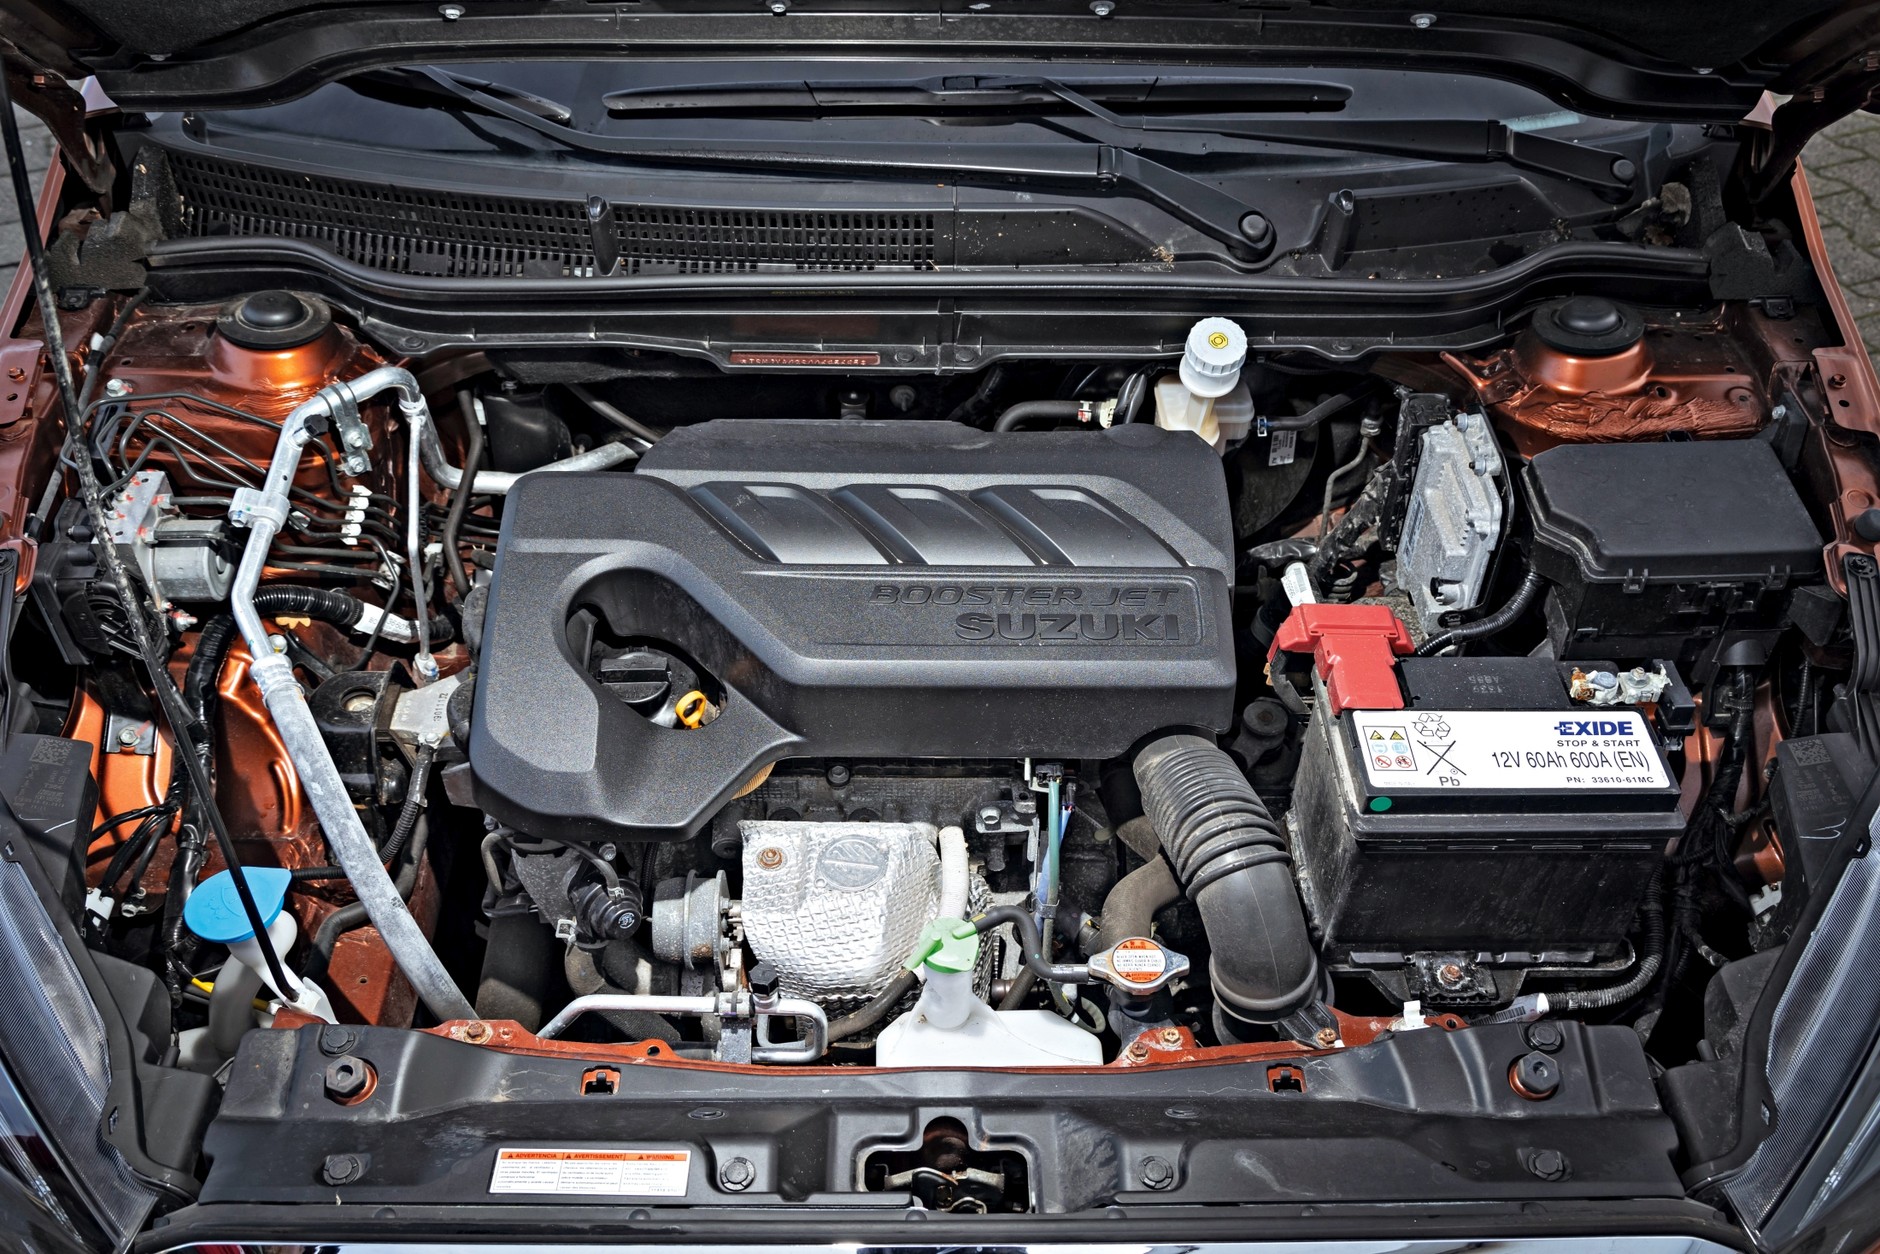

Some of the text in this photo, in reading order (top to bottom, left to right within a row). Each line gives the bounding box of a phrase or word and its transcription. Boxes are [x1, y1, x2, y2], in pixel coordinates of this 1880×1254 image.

[868, 585, 1180, 607] BOOSTER JET
[955, 612, 1180, 641] SUZUKI
[1554, 721, 1633, 736] EXIDE
[1492, 751, 1650, 772] 12V 60Ah 600A (EN)
[1439, 776, 1460, 787] Pb
